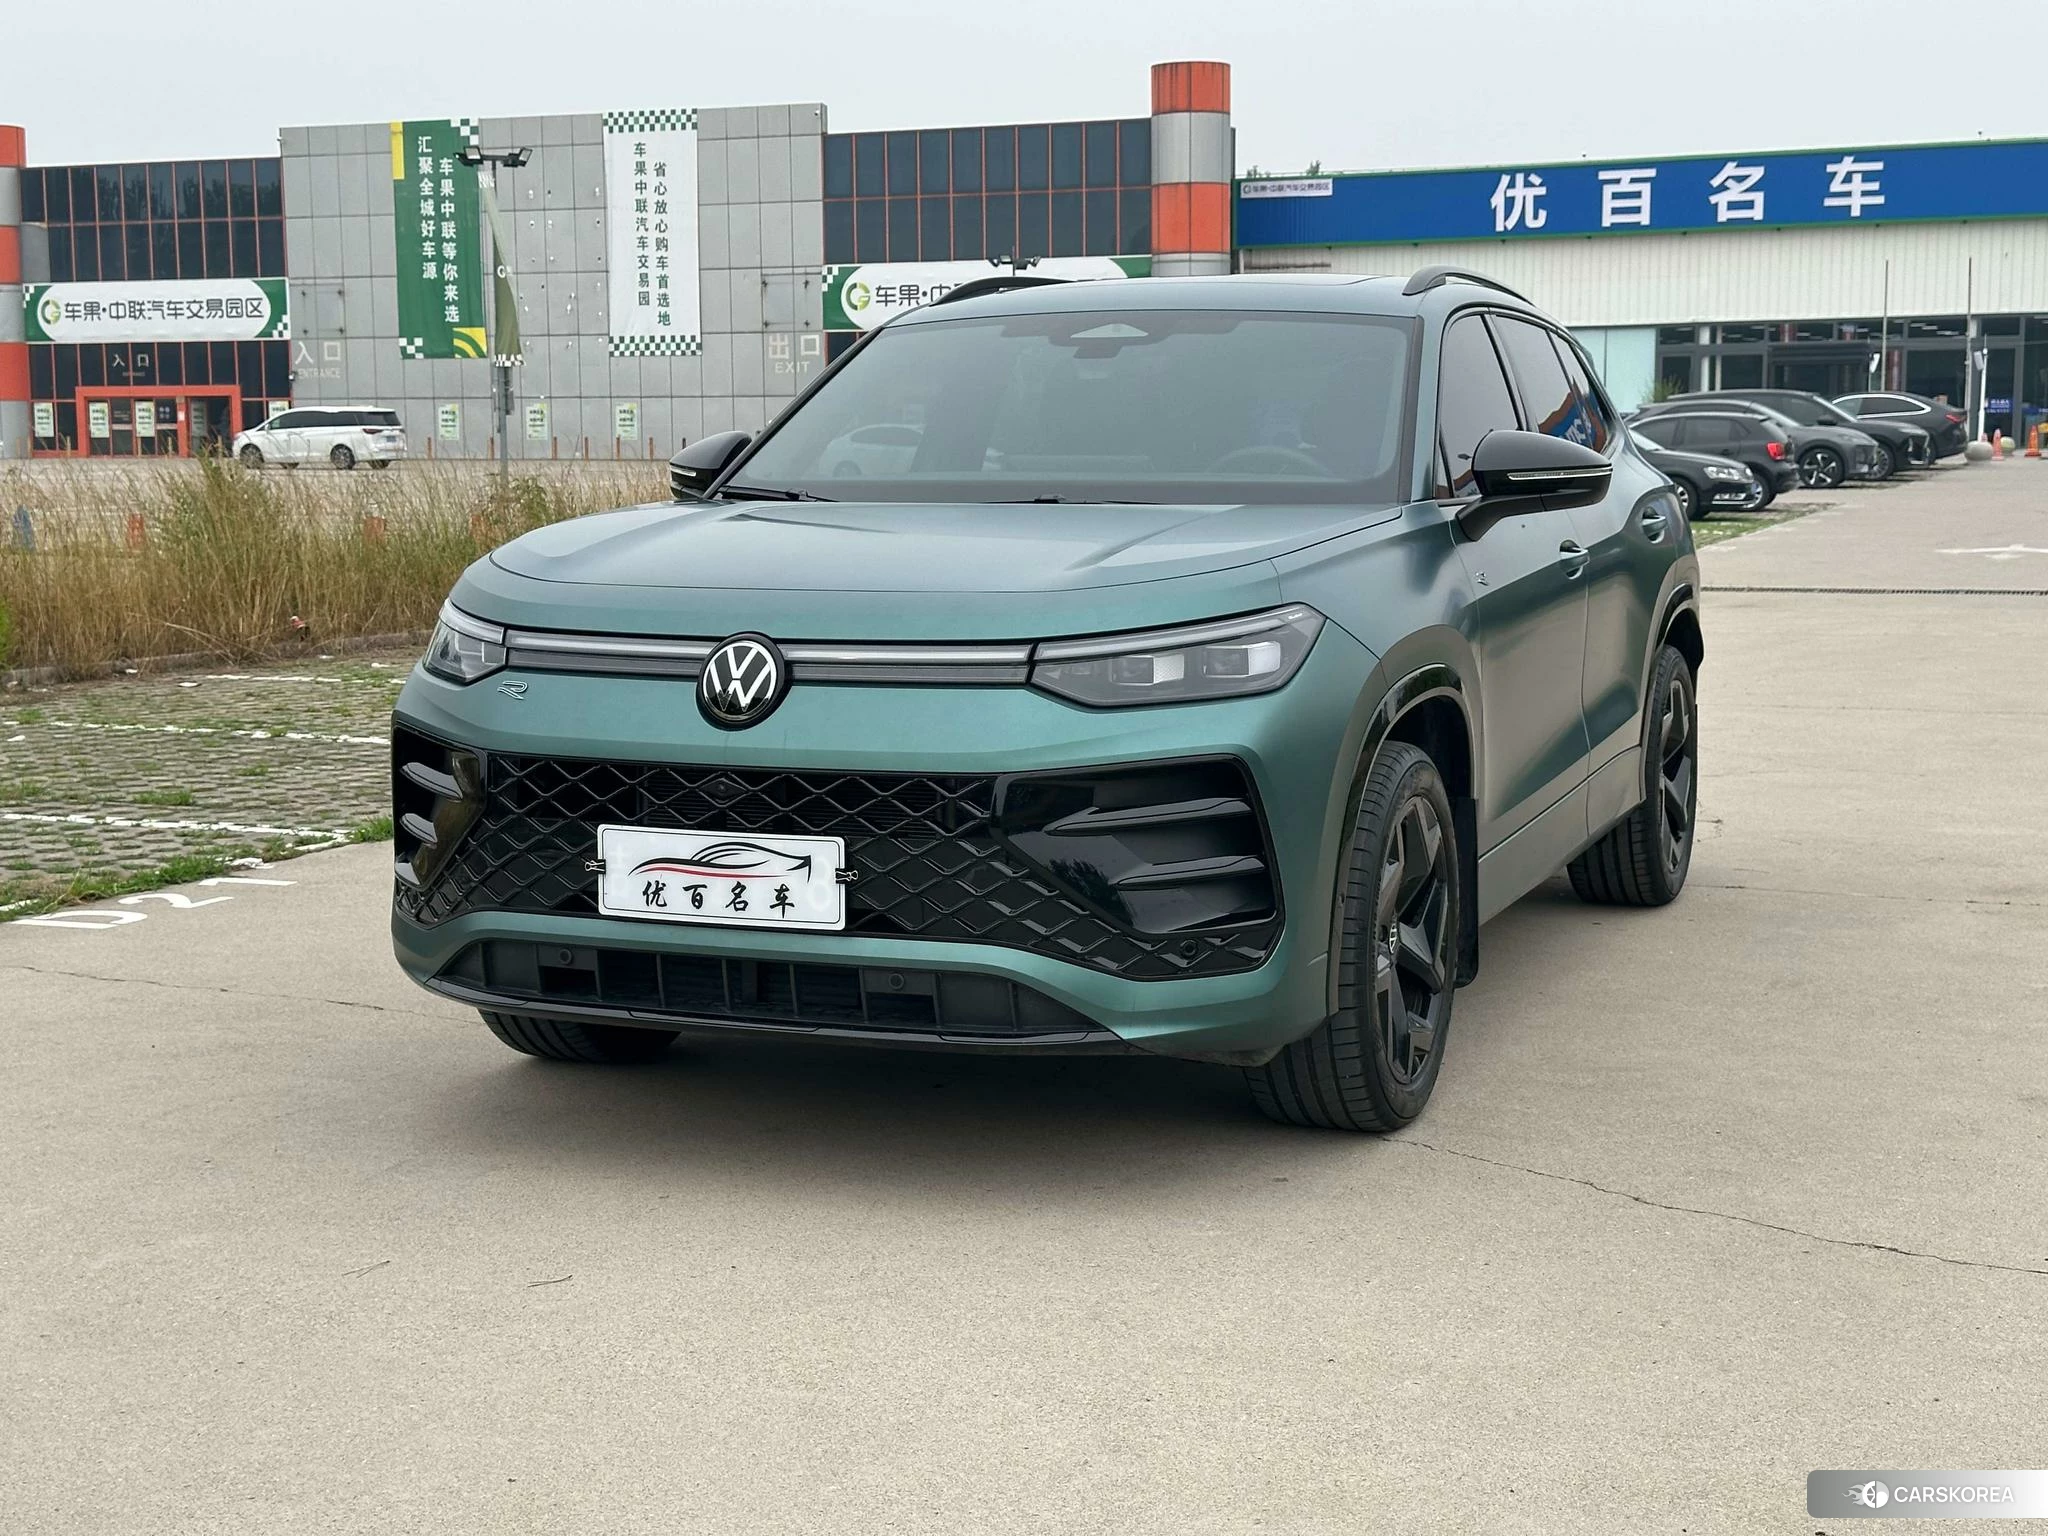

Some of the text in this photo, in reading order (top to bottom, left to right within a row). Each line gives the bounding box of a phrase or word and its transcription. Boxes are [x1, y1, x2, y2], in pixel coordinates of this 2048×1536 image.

[418, 136, 438, 280] 汇聚全城好车源
[1490, 155, 1886, 232] 优百名车
[439, 158, 460, 323] 车果中联等你来选
[633, 142, 650, 306] 车果中联汽车交易园
[653, 161, 671, 326] 省心放心购车首选地
[112, 353, 149, 368] 入口
[295, 340, 341, 364] 入口
[768, 333, 820, 359] 出口
[775, 361, 810, 374] EXIT
[497, 680, 528, 700] R
[642, 880, 795, 919] 优百名车
